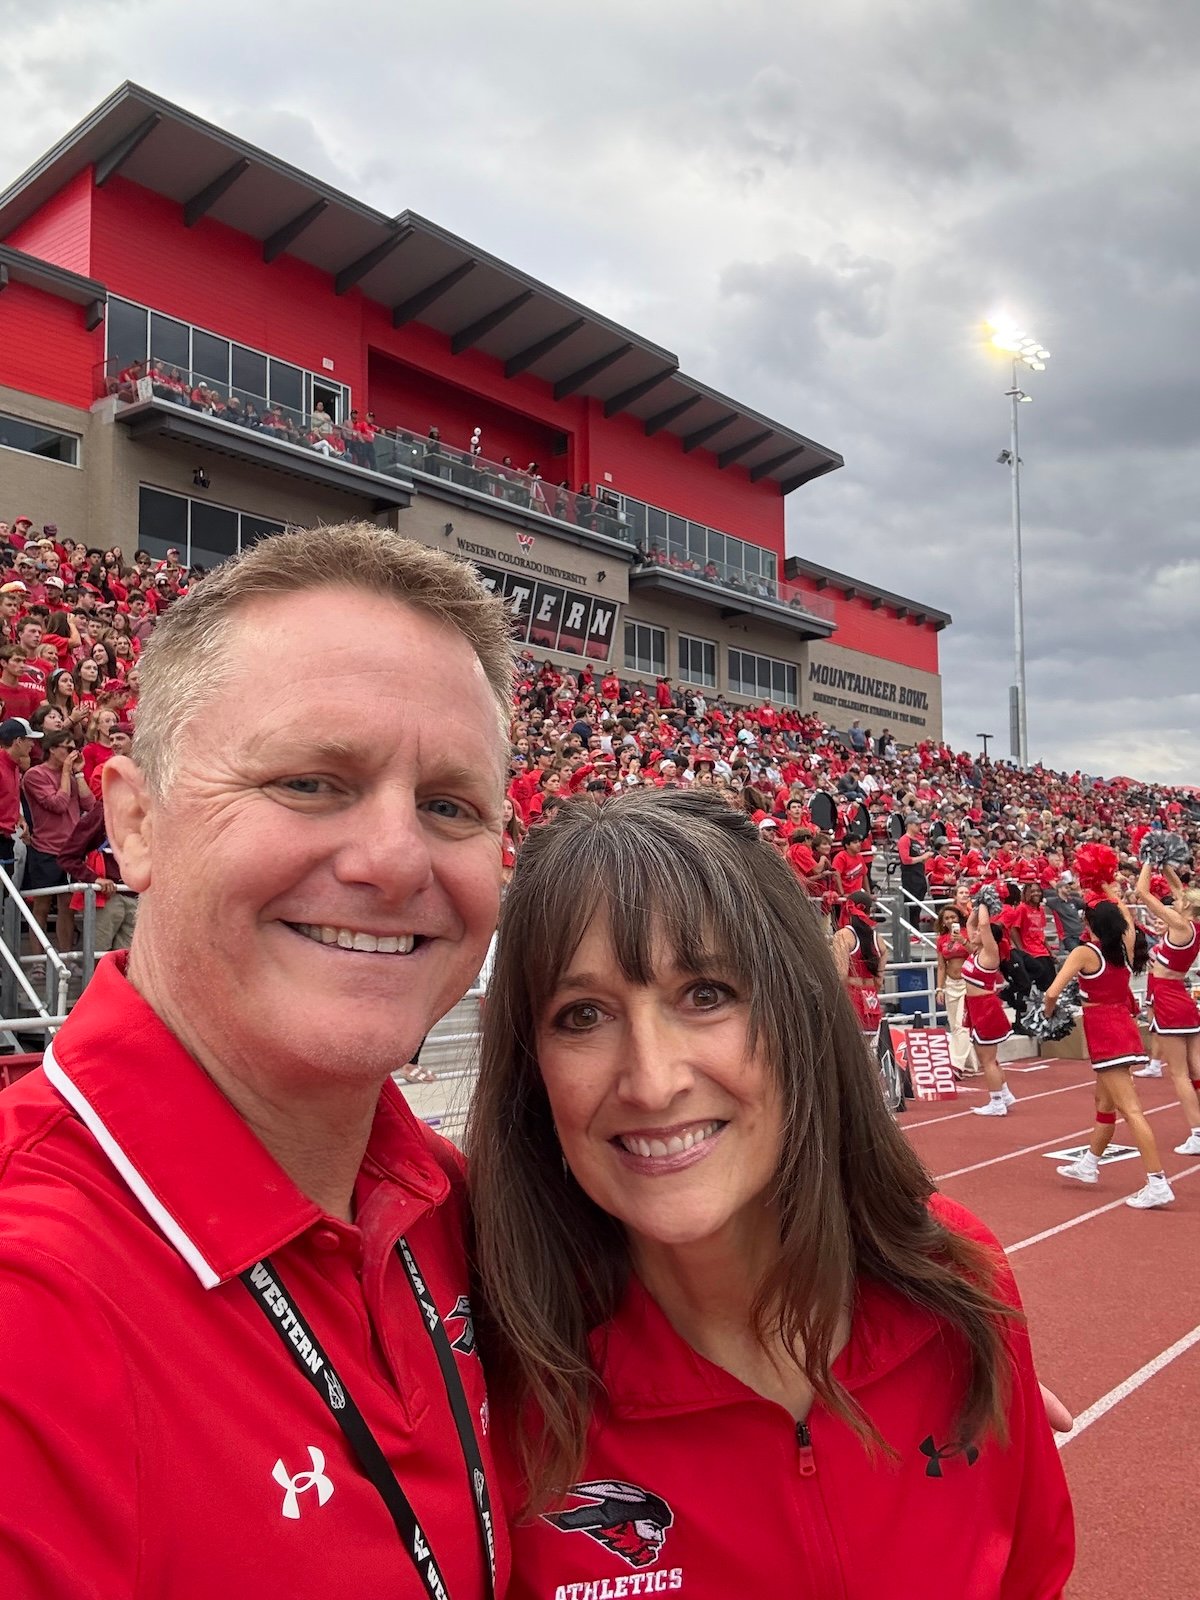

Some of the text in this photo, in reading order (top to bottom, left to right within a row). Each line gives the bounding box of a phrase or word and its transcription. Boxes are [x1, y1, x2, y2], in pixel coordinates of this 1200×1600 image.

[457, 537, 587, 585] WESTERN COLORADO UNIVERSITY
[481, 577, 612, 636] TERN
[808, 662, 929, 711] MOUNTAINEER BOWL
[908, 1032, 937, 1101] TOUCH
[928, 1034, 956, 1093] DOWN
[250, 1261, 324, 1374] WESTERN
[555, 1567, 683, 1600] ATHLETICS
